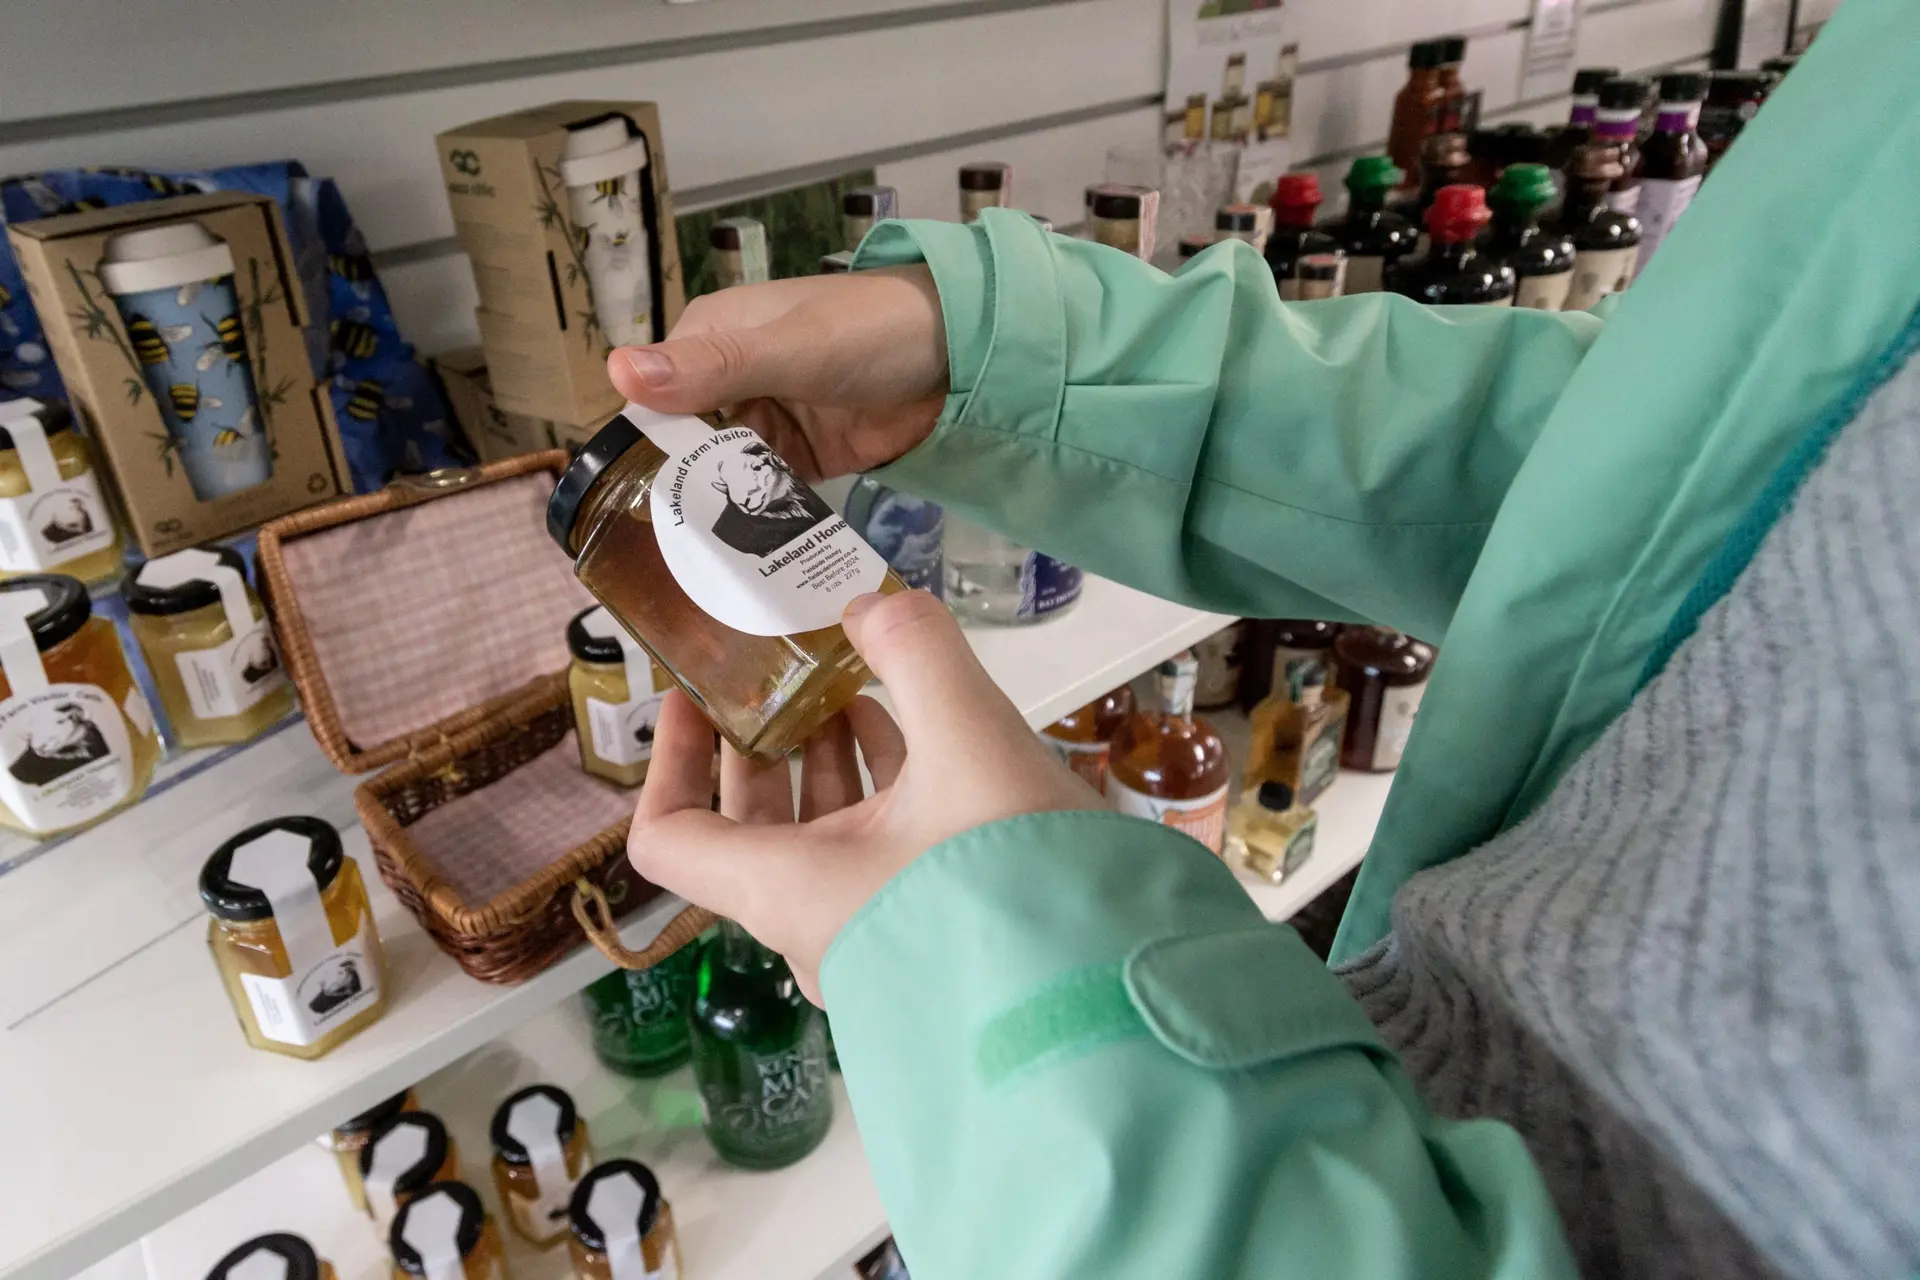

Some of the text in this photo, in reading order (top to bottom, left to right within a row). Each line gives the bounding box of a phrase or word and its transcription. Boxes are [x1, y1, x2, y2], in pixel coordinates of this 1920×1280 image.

[669, 429, 753, 527] Lakeland Farm Visitor
[758, 520, 847, 578] Lakeland Hone
[799, 547, 825, 565] Produced
[824, 548, 842, 561] Honey
[811, 555, 860, 590] Best Before 2024
[844, 567, 861, 580] 227g
